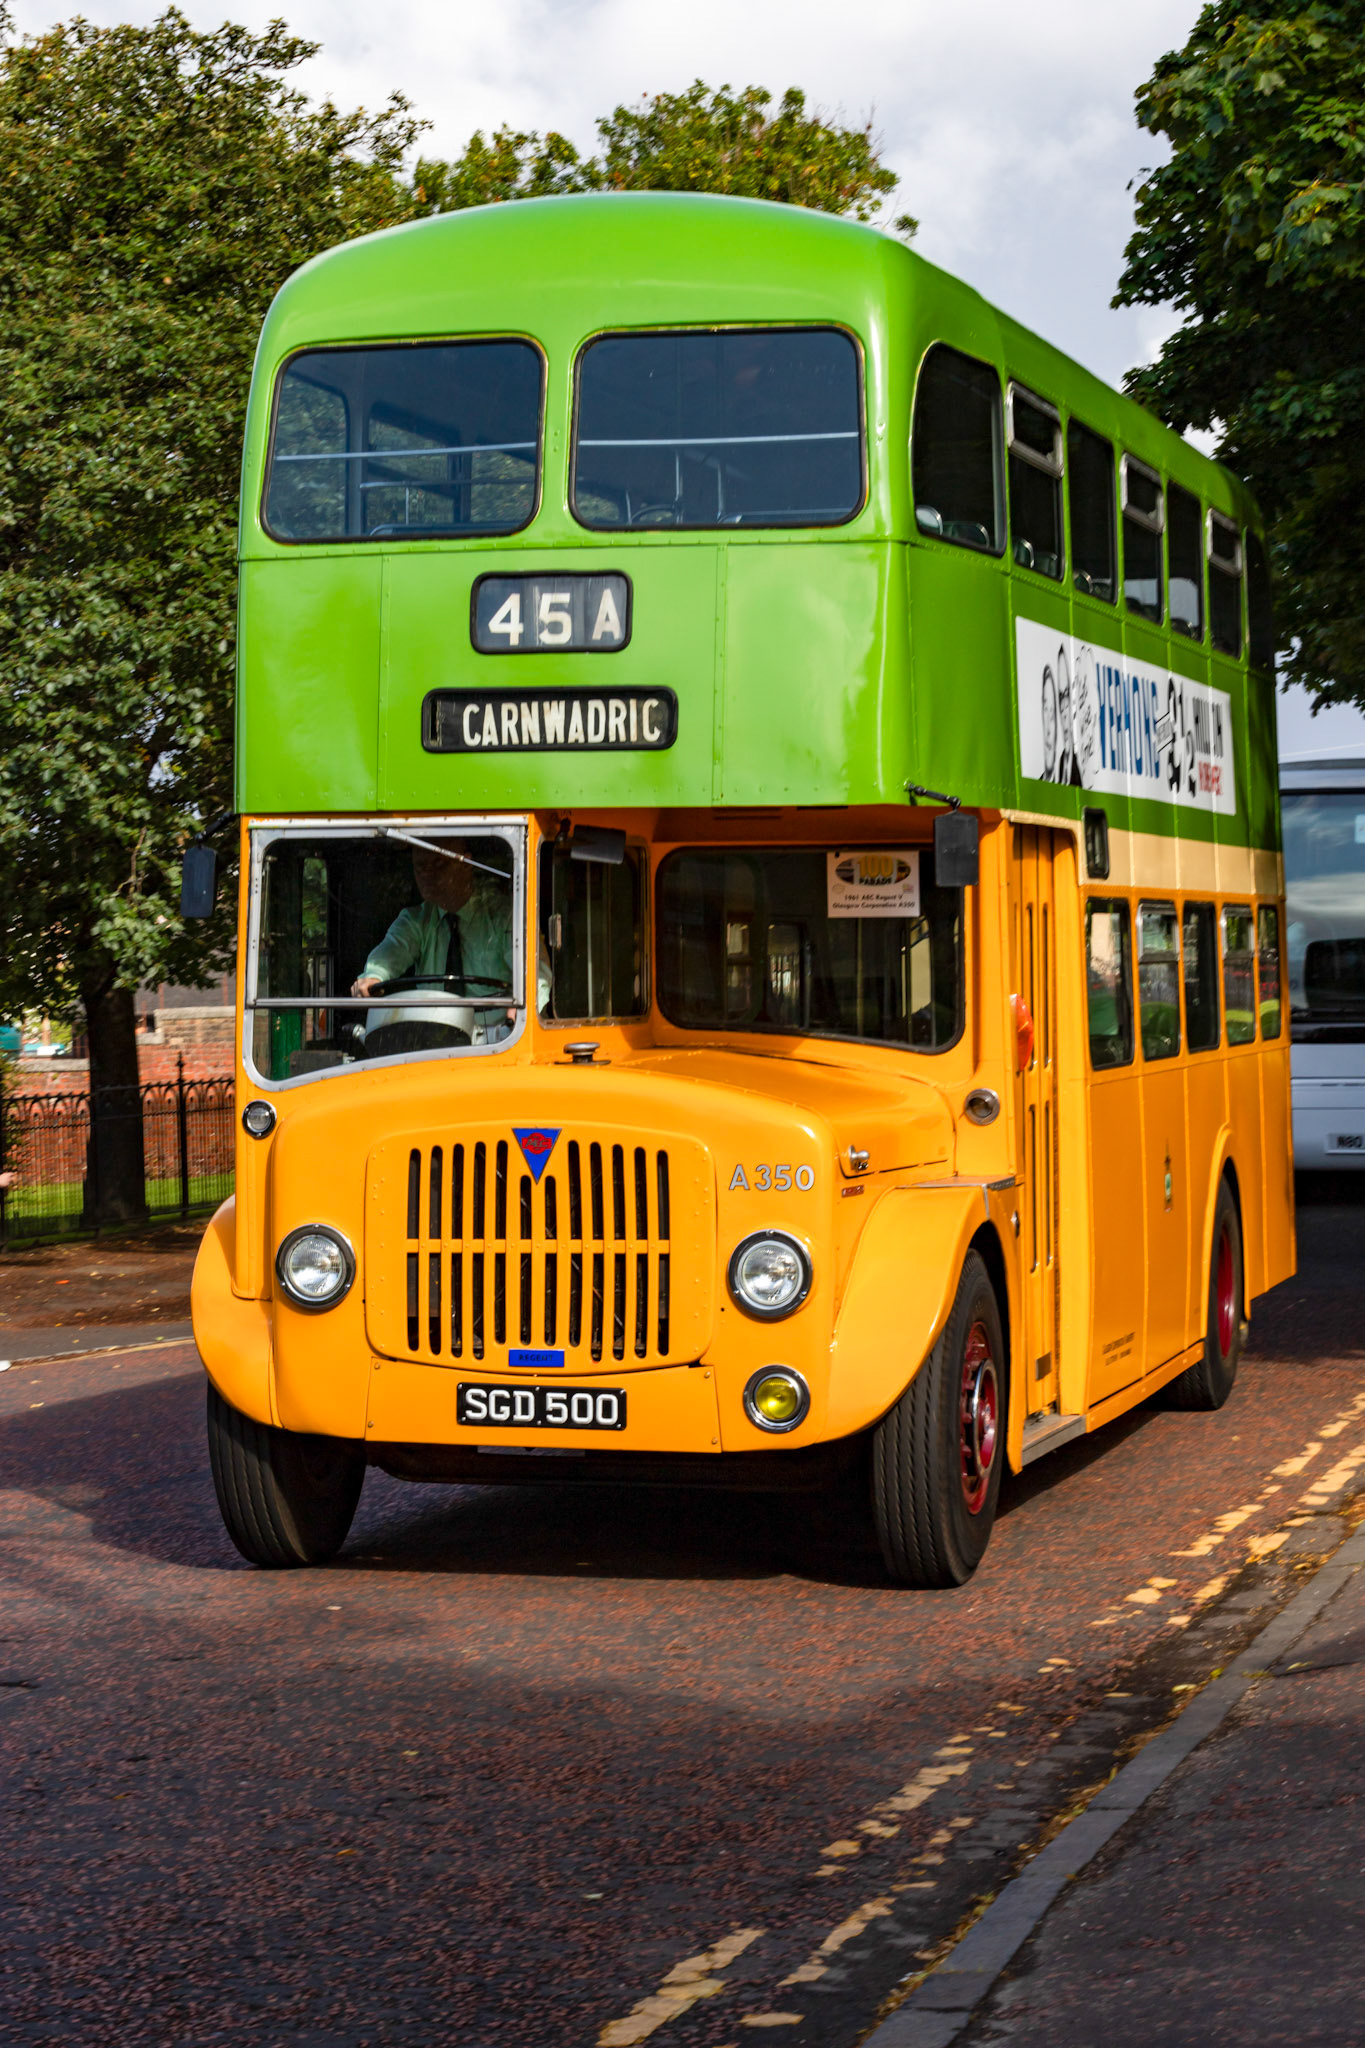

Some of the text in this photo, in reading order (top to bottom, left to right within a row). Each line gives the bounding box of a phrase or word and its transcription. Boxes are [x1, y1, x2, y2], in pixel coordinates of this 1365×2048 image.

[462, 698, 661, 746] CARNWADRIC
[858, 855, 894, 878] 100
[518, 1353, 553, 1362] REGENT
[465, 1388, 618, 1426] SGD 500
